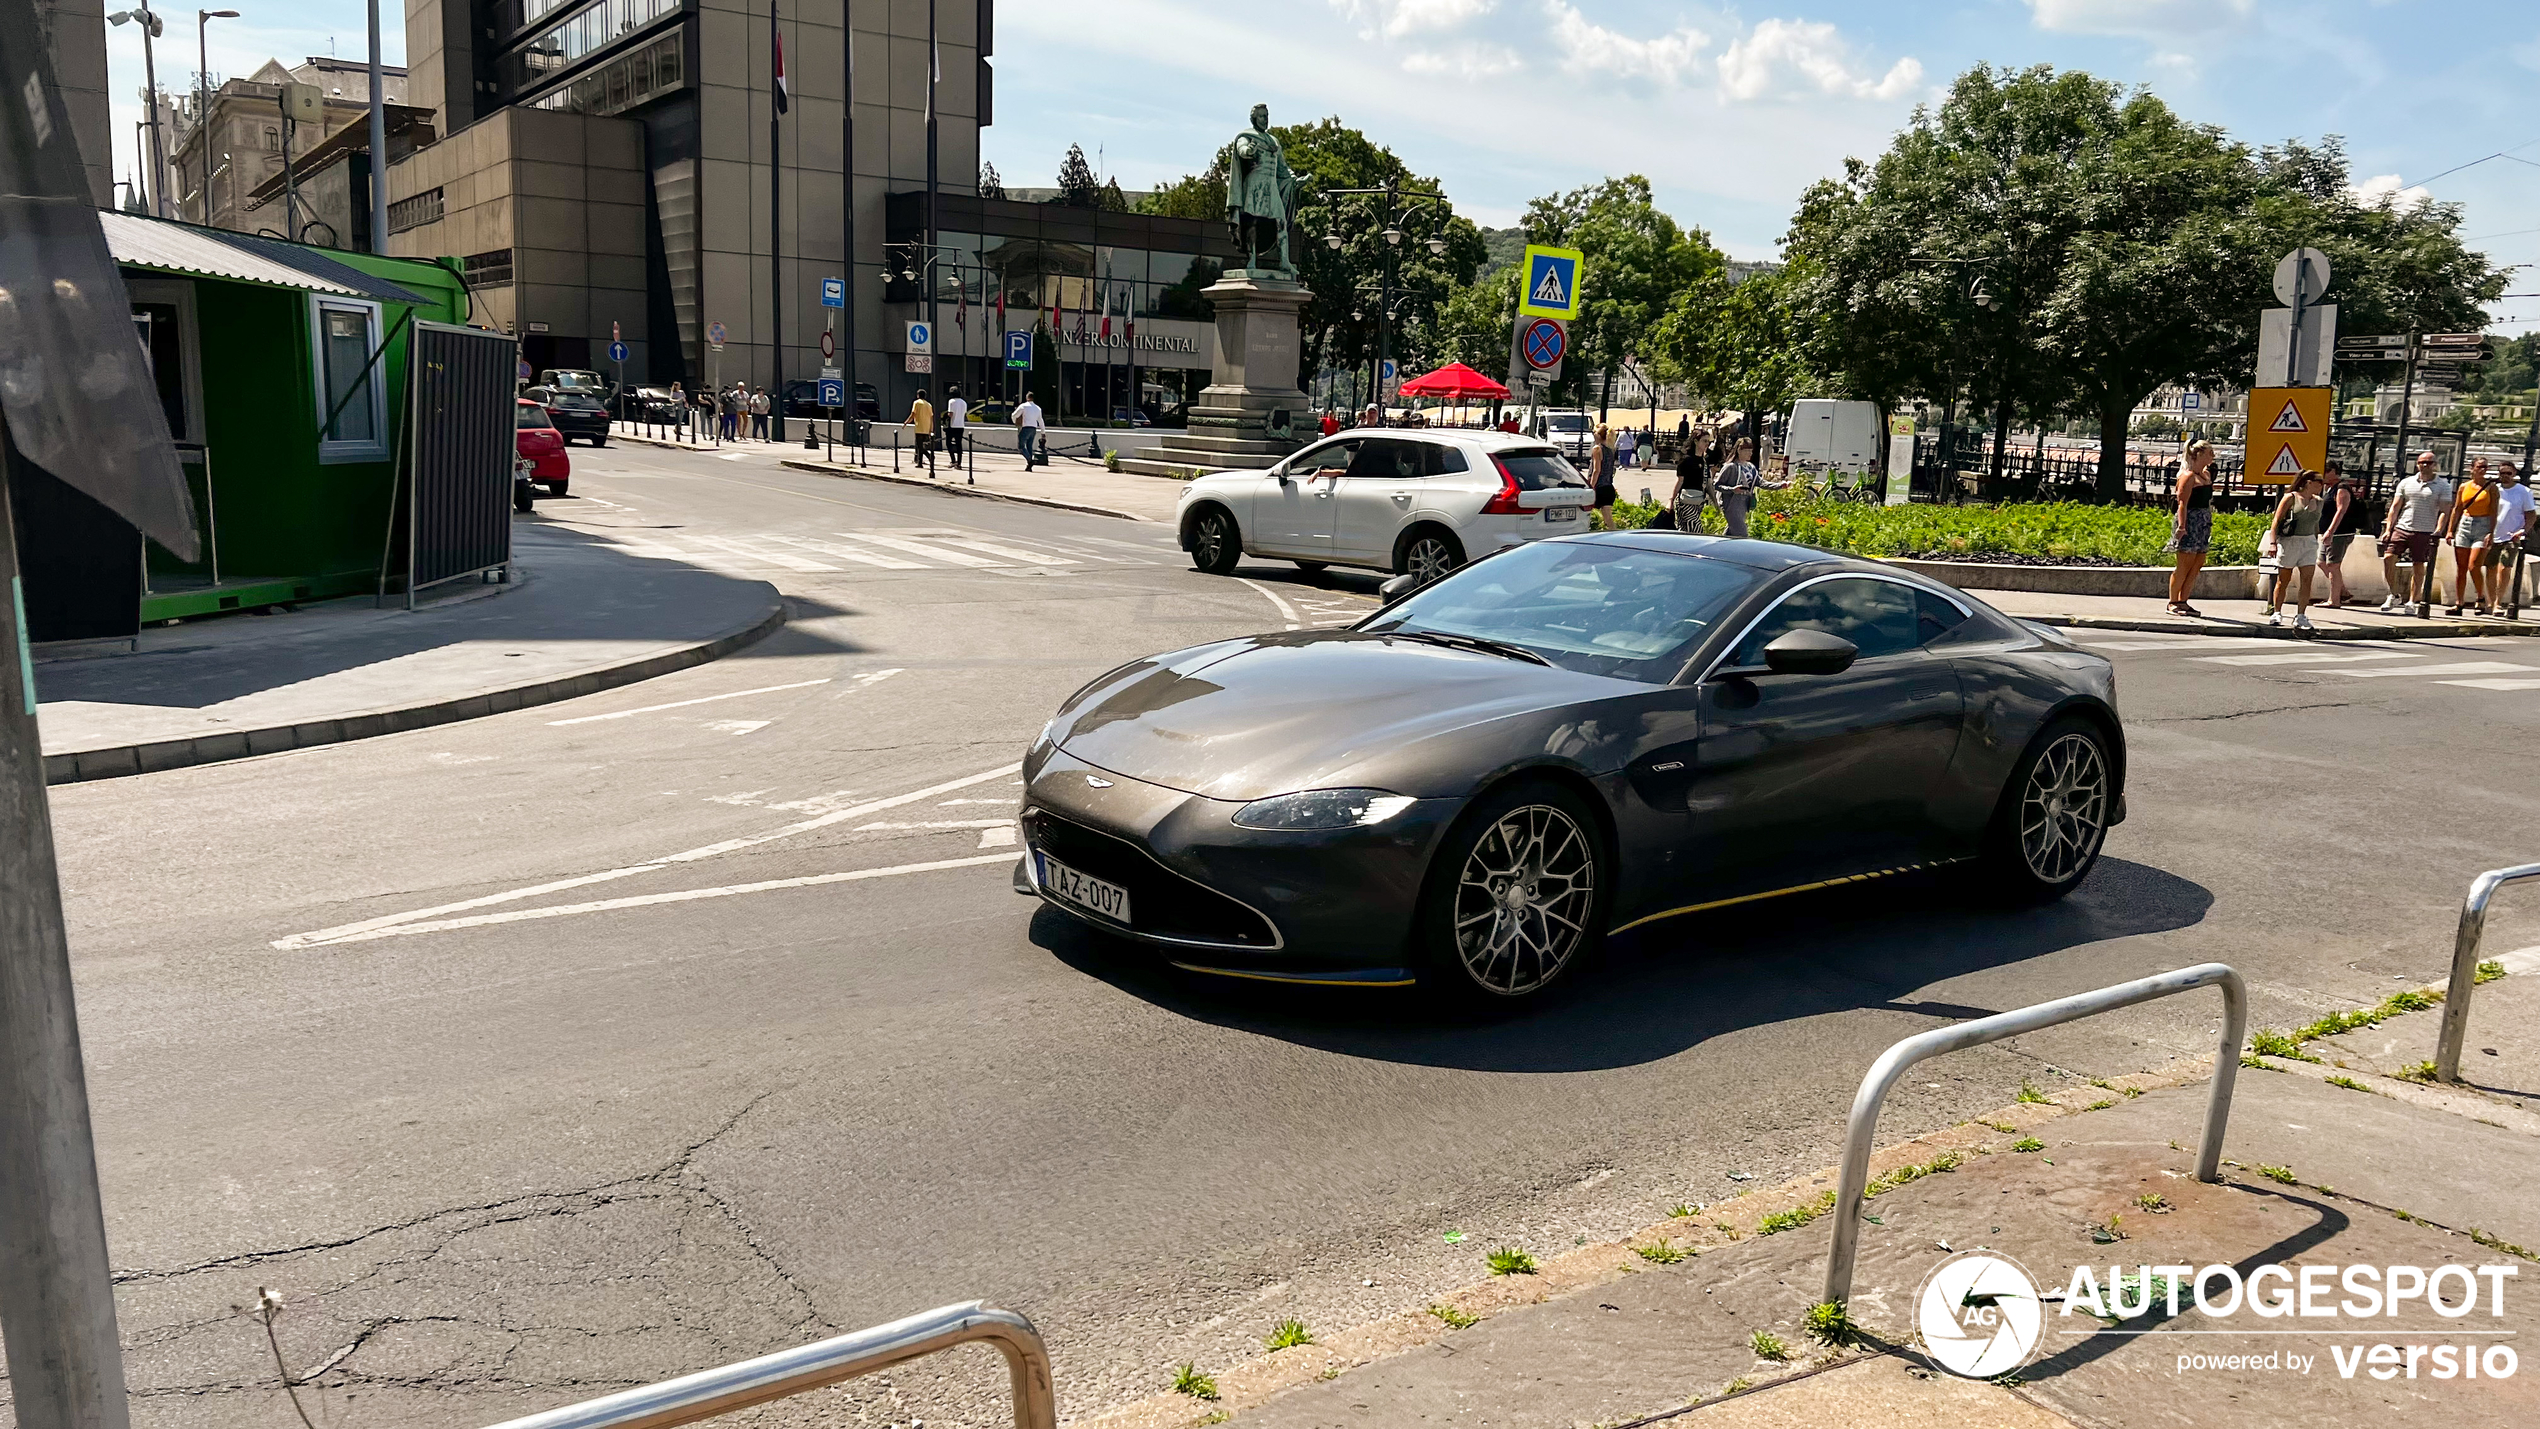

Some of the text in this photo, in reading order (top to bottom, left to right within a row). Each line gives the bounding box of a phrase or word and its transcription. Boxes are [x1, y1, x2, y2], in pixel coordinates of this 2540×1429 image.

[1011, 336, 1026, 359] P
[1057, 329, 1196, 352] NERCONTINENTAL
[825, 387, 837, 403] P
[1045, 859, 1123, 915] TAZ-007
